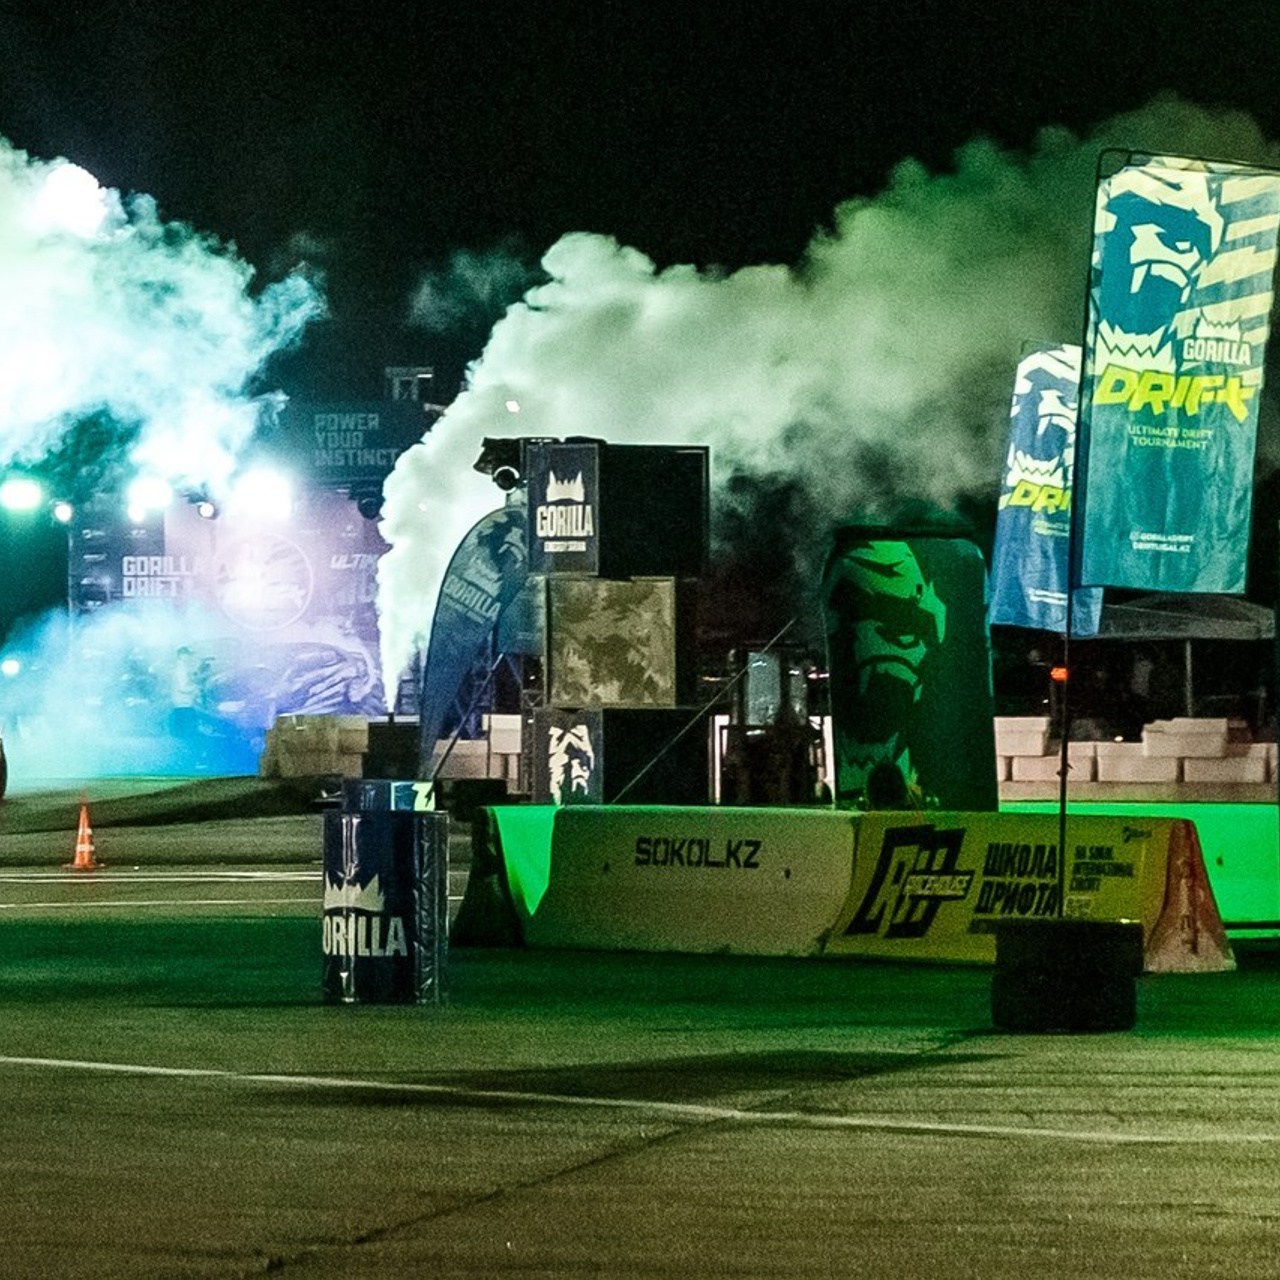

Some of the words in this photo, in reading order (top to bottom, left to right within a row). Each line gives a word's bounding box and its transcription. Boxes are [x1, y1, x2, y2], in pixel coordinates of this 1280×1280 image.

[1183, 338, 1252, 365] GORILLA
[1092, 363, 1256, 423] DRIFT
[314, 413, 380, 430] POWER
[1128, 424, 1178, 439] ULTIMATE
[315, 431, 364, 447] YOUR
[1132, 436, 1208, 450] TOURNAMENT
[536, 504, 594, 537] GORILLA
[443, 574, 501, 622] GORILLA
[983, 842, 1057, 878] ШКОЛА
[974, 880, 1061, 916] ДРИФТА
